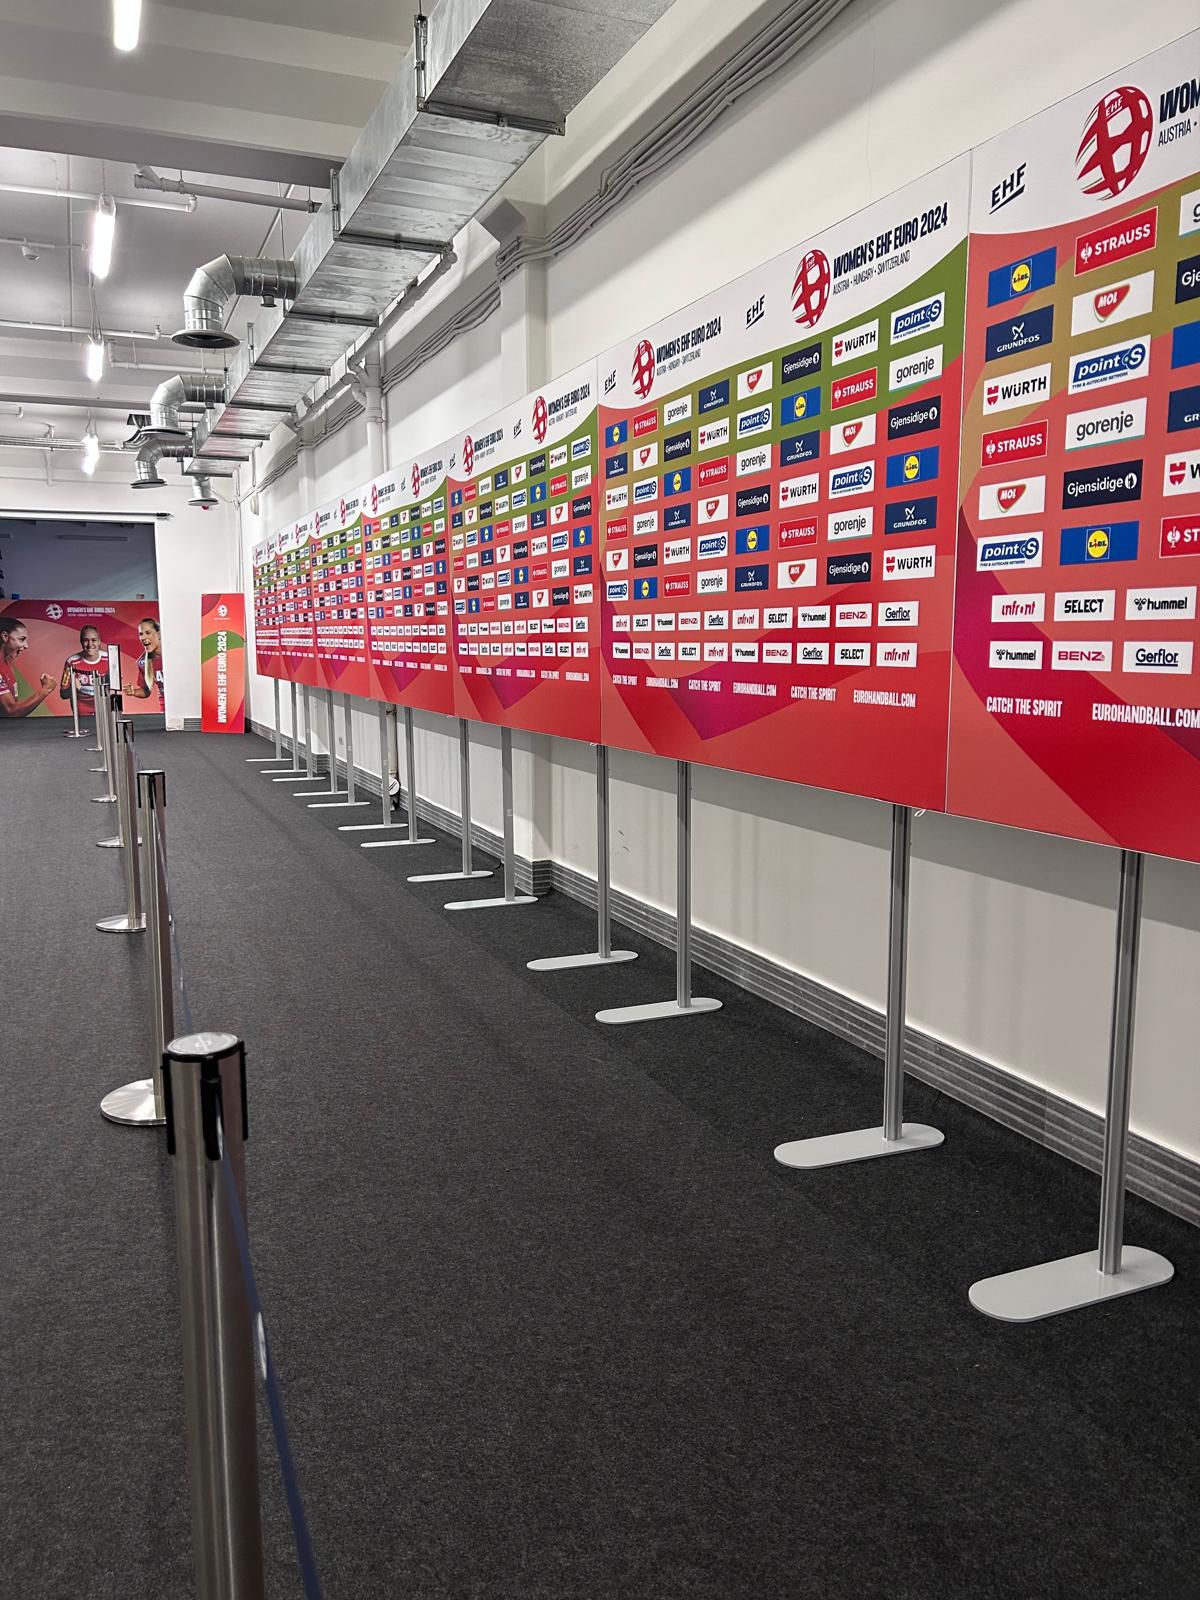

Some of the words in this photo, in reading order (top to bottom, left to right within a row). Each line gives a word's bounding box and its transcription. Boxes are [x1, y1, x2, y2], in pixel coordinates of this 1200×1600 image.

[1158, 118, 1192, 147] AUSTRIA
[991, 162, 1027, 208] EHF
[833, 239, 875, 280] WOMEN'S
[876, 230, 893, 259] EHF
[894, 217, 919, 251] EURO
[920, 201, 948, 238] 2024
[1094, 223, 1151, 256] STRAUSS
[746, 294, 765, 324] EHF
[1097, 291, 1118, 309] MOL
[897, 308, 925, 332] point
[844, 330, 876, 352] WÜRTH
[996, 333, 1041, 353] GRUNDFOS
[896, 356, 935, 384] gorenje
[1078, 357, 1120, 379] point
[604, 369, 616, 391] EHF
[842, 378, 874, 398] STRAUSS
[1001, 376, 1047, 400] WÜRTH
[890, 411, 929, 430] Gjensidige
[1076, 411, 1134, 441] gorenje
[997, 433, 1043, 453] STRAUSS
[741, 451, 767, 471] gorenje
[834, 471, 858, 489] point
[1067, 476, 1124, 497] Gjensidige
[790, 482, 817, 498] WÜRTH
[1000, 489, 1017, 500] MOL
[788, 526, 815, 539] STRAUSS
[834, 515, 866, 535] gorenje
[893, 518, 927, 529] GRUNDFOS
[985, 543, 1020, 559] point
[829, 563, 861, 576] Gjensidige
[897, 555, 933, 570] WÜRTH
[885, 606, 911, 620] Gerflor
[1064, 599, 1104, 614] SELECT
[1147, 597, 1188, 610] hummel
[768, 612, 788, 624] SELECT
[839, 611, 866, 620] BENZ
[217, 631, 227, 652] 2024
[840, 648, 864, 660] SELECT
[1005, 649, 1036, 661] hummel
[1058, 651, 1102, 661] BENZ
[1136, 648, 1179, 664] Gerflor
[791, 686, 807, 699] CATCH
[808, 686, 818, 700] THE
[818, 687, 836, 701] SPIRIT
[853, 689, 916, 708] EUROHANDBALL.COM
[986, 696, 1013, 714] CATCH
[1015, 698, 1031, 716] THE
[1032, 699, 1062, 718] SPIRIT
[1092, 703, 1200, 729] EUROHANDBALL.COM
